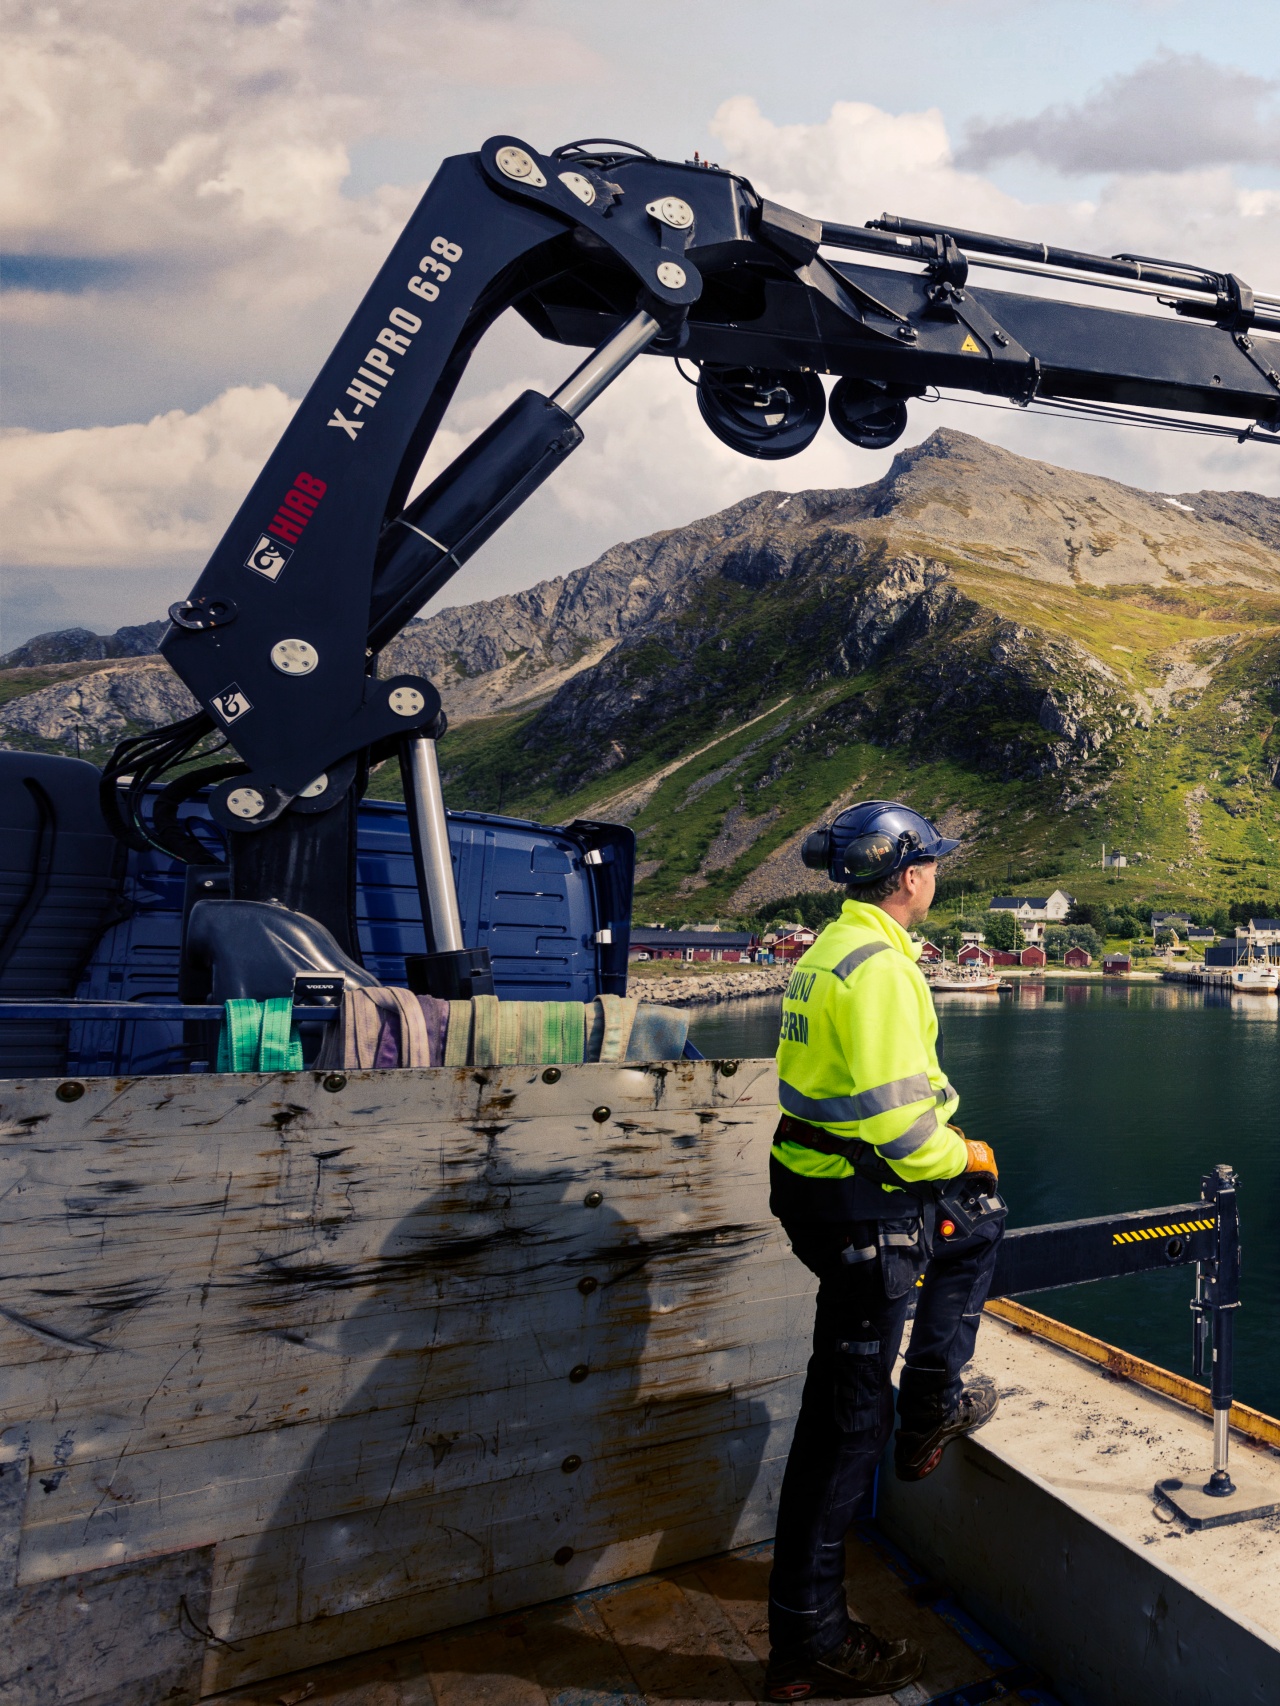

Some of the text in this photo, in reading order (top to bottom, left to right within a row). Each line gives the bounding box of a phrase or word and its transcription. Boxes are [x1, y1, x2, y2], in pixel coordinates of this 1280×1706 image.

[327, 235, 463, 442] X-HIPRO 638
[266, 471, 328, 546] HIAB
